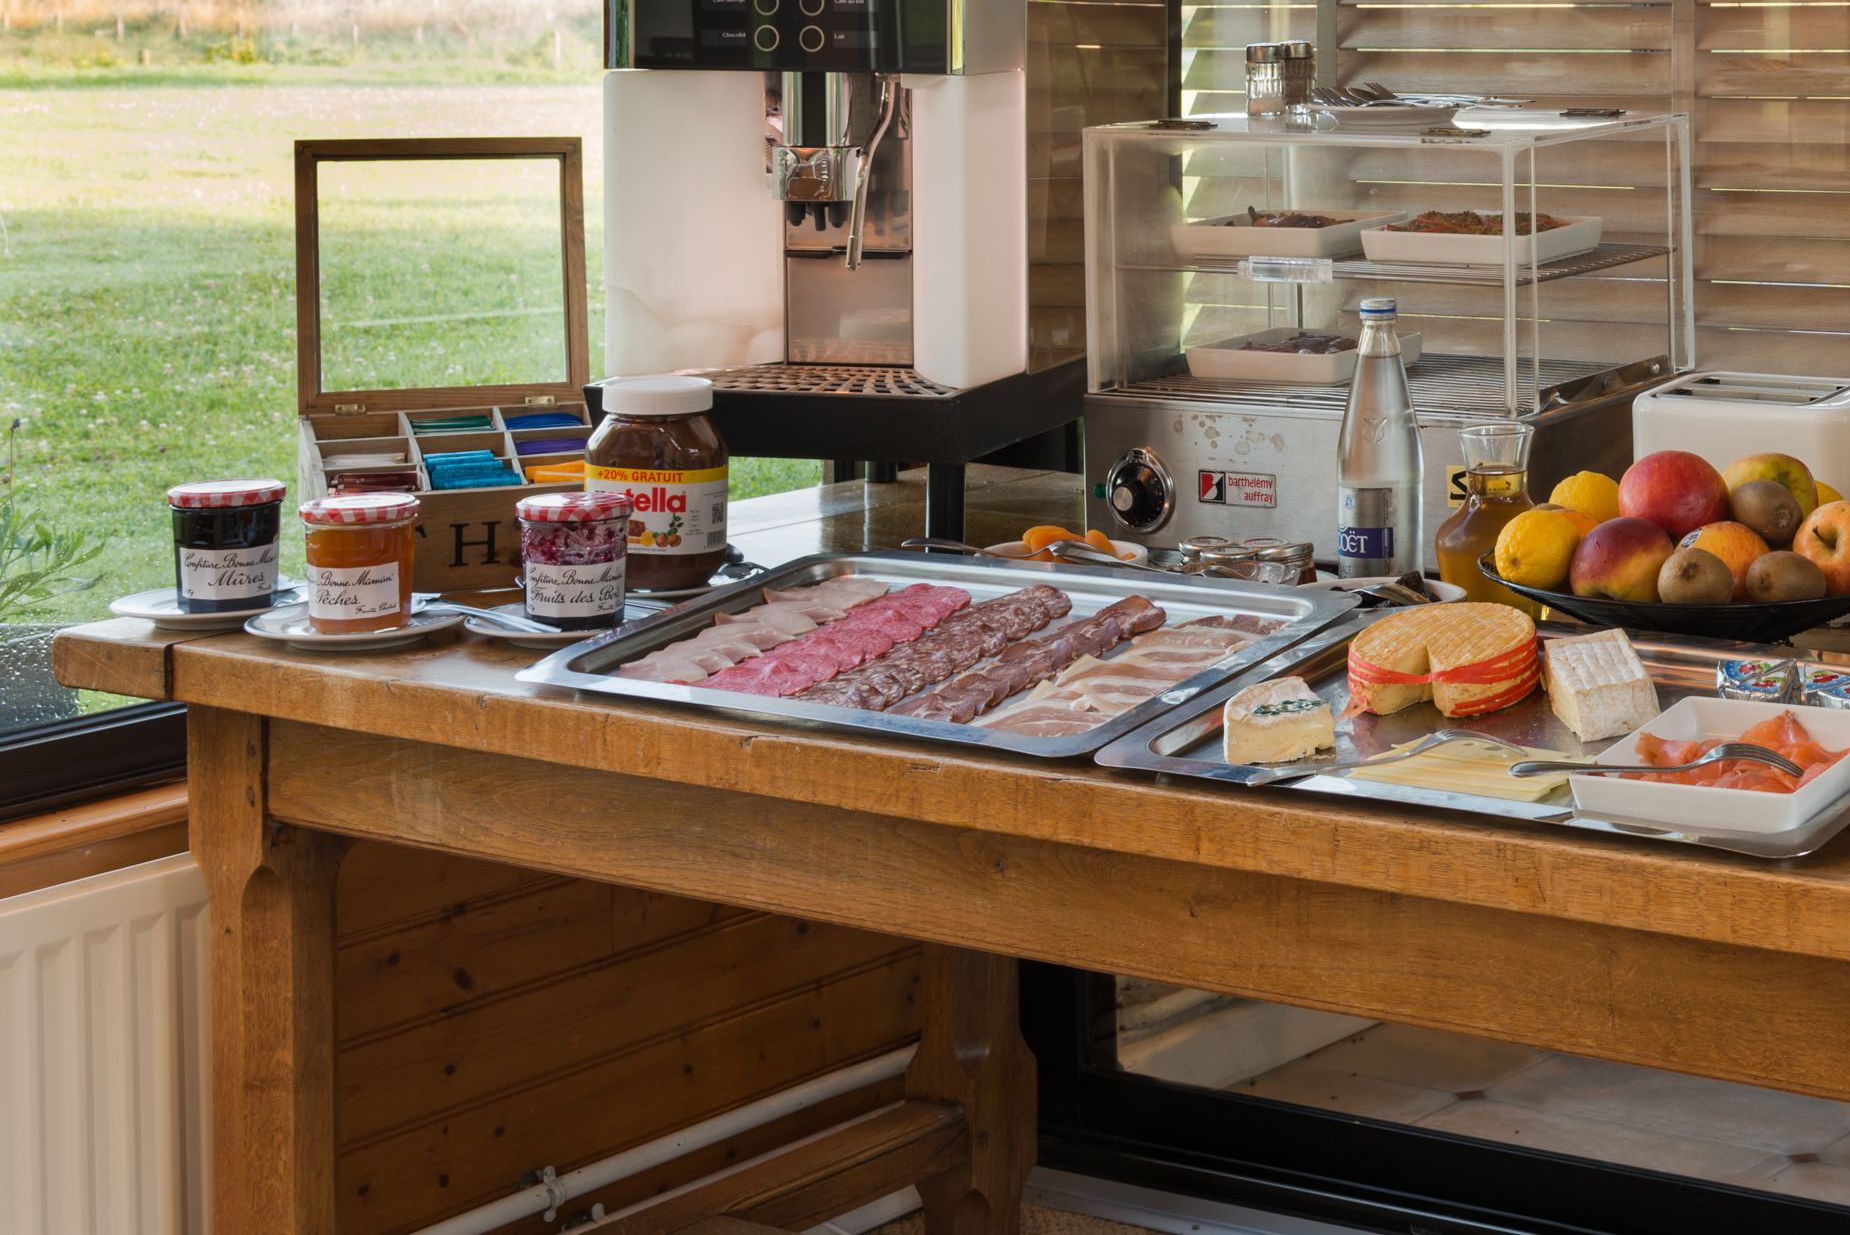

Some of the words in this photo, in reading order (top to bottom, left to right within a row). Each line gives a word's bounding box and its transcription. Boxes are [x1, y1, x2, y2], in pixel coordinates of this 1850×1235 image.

[598, 469, 628, 481] +20%
[631, 472, 685, 483] GRATUIT
[1243, 491, 1273, 504] auffray
[223, 552, 257, 569] Bonne
[208, 569, 266, 587] Mûres
[320, 570, 351, 587] Bonne
[352, 569, 394, 587] Maman
[561, 569, 597, 585] Bonne
[531, 586, 565, 603] Fruits
[570, 590, 596, 603] des
